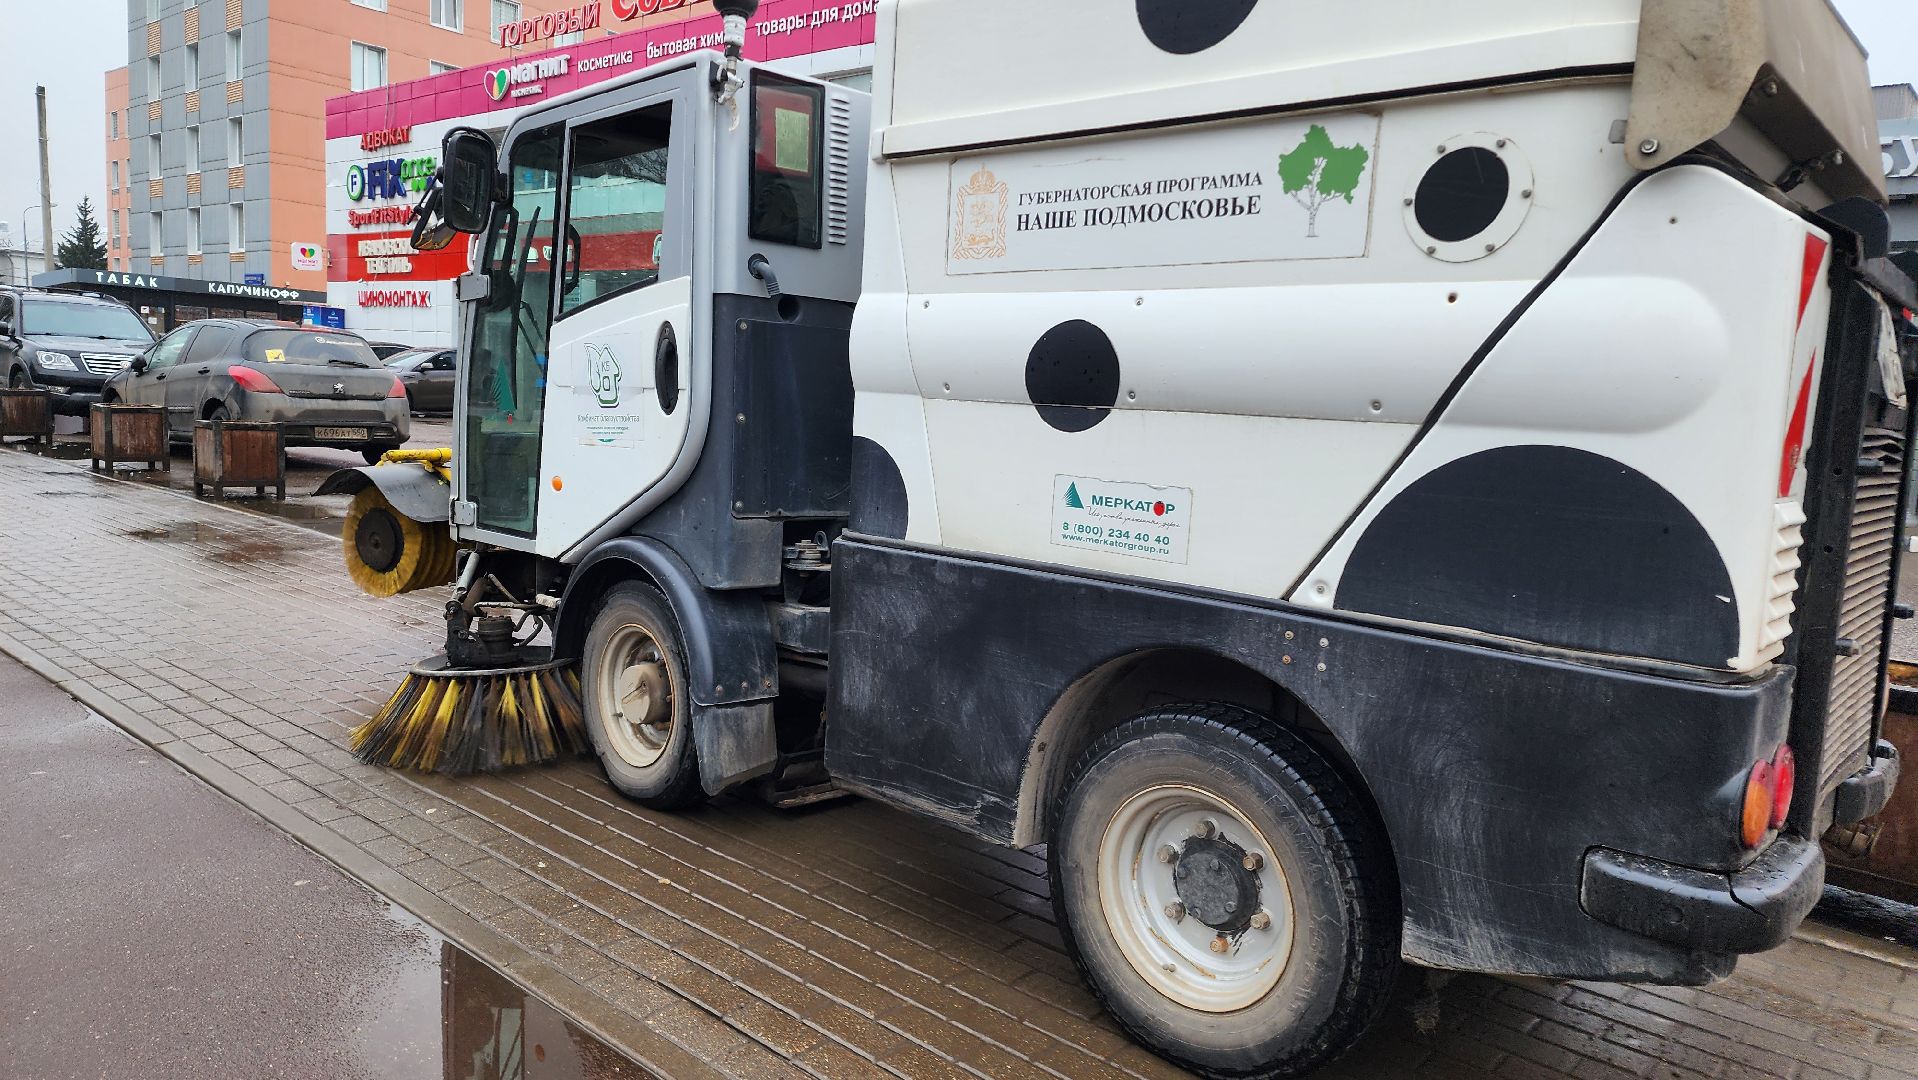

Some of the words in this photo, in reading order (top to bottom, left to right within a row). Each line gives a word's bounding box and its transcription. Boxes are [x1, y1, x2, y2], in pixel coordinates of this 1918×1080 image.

[498, 0, 600, 49] ТОРГОВЫЙ
[755, 16, 808, 37] товары
[810, 7, 839, 29] для
[577, 50, 633, 73] косметика
[646, 37, 697, 59] бытовая
[700, 30, 725, 48] хим
[360, 125, 412, 153] АДВОКАТ
[1019, 181, 1153, 206] ГУБЕРНАТОРСКАЯ
[1156, 171, 1263, 195] ПРОГРАММА
[1016, 209, 1077, 232] НАШЕ
[1083, 194, 1261, 230] ПОДМОСКОВЬЕ
[95, 271, 158, 289] ТАБАК
[207, 281, 300, 300] КАПУЧИНОФФ
[357, 289, 431, 308] ШИНОМОНТАЖ
[1091, 494, 1176, 517] МЕРКАТОР
[1061, 532, 1170, 555] www.merkatorgroup.ru
[1062, 521, 1070, 531] 8
[1073, 523, 1103, 538] (800)
[1108, 528, 1131, 540] 234
[1134, 532, 1150, 543] 40
[1154, 536, 1170, 546] 40
